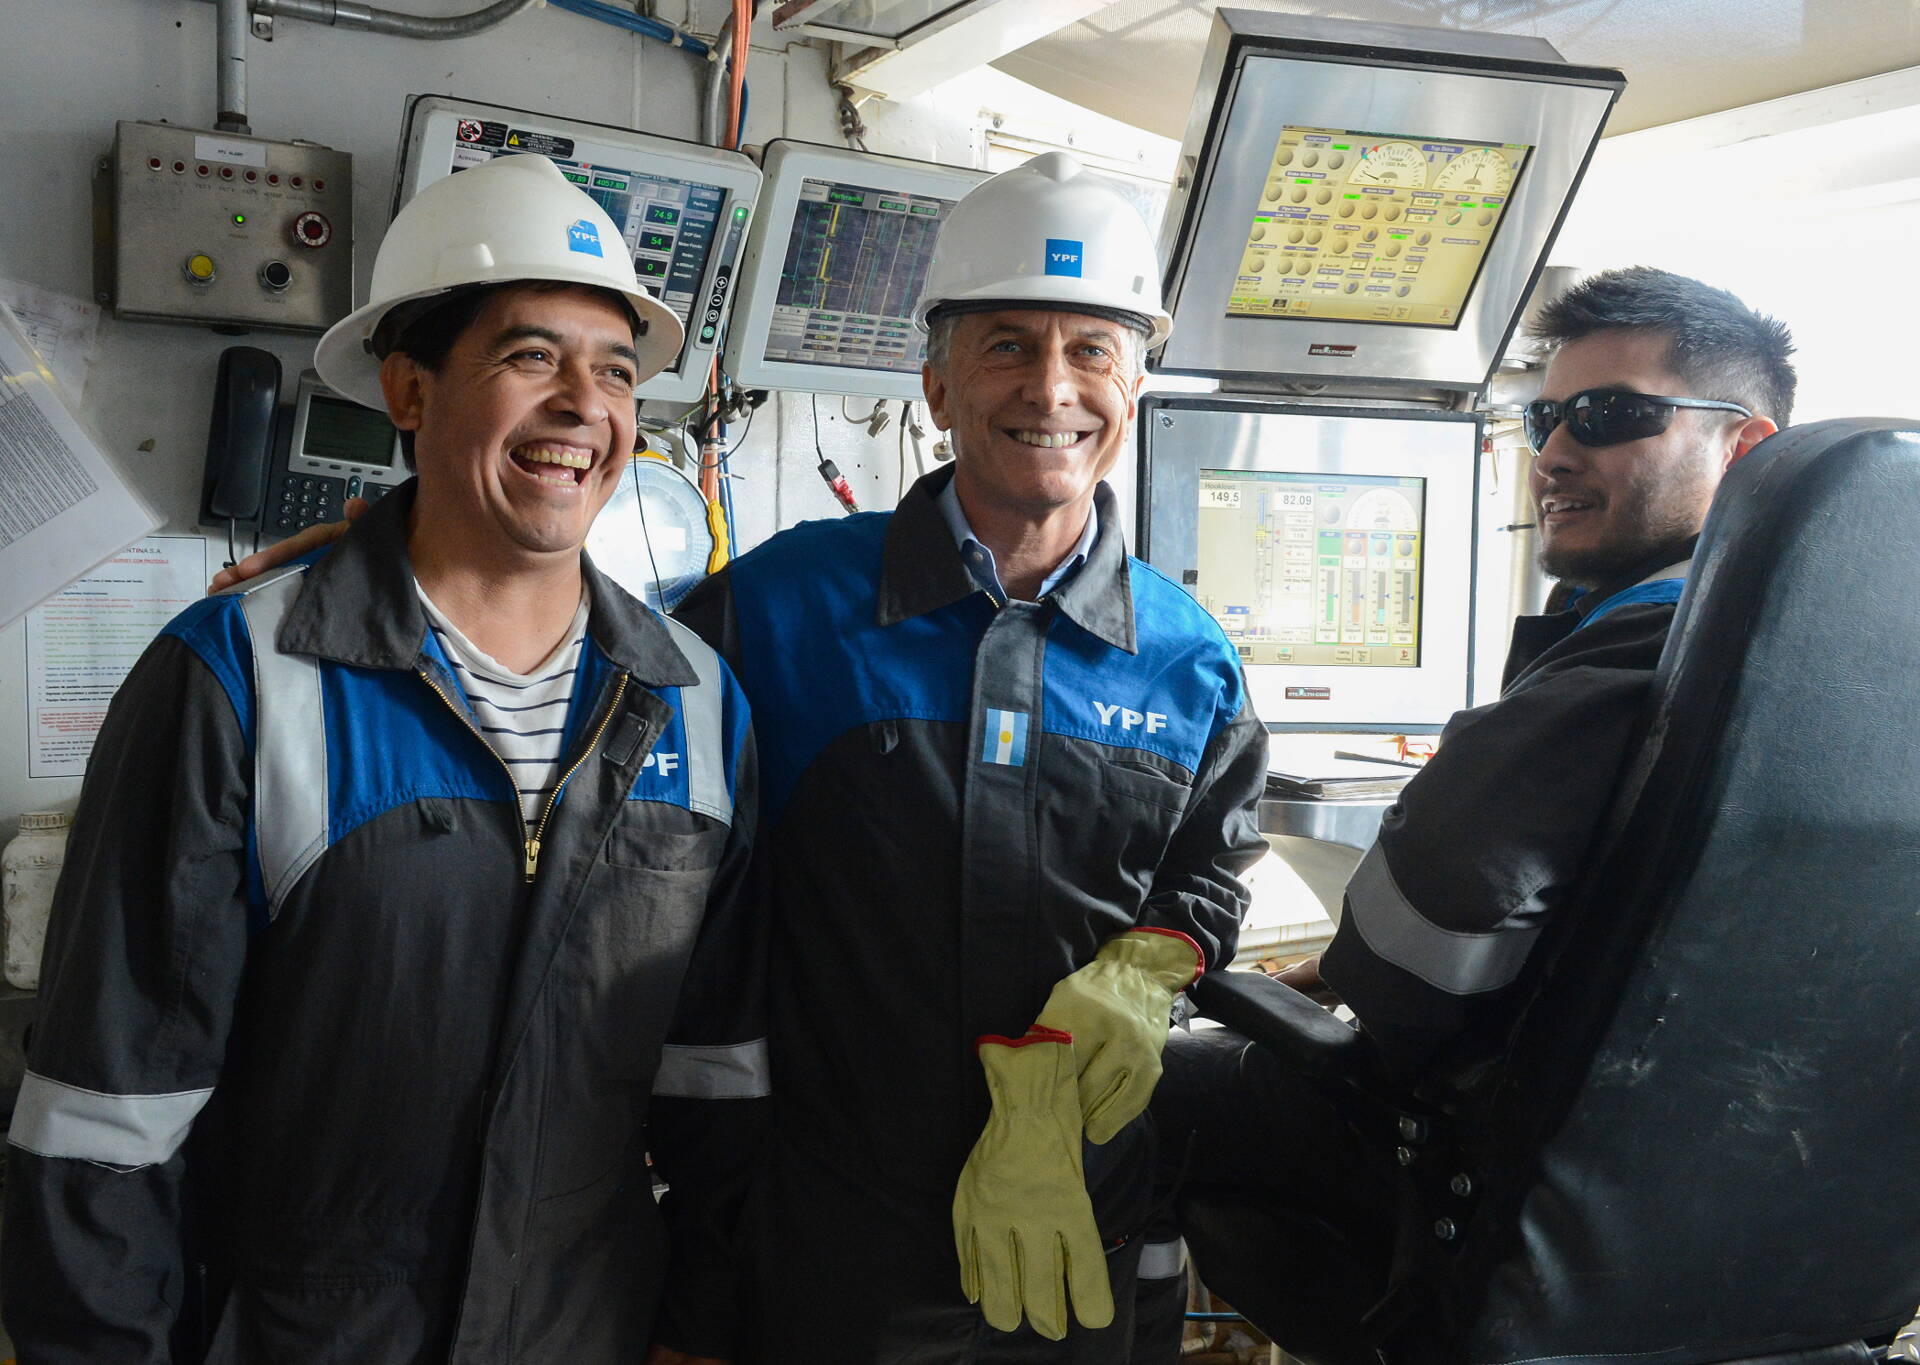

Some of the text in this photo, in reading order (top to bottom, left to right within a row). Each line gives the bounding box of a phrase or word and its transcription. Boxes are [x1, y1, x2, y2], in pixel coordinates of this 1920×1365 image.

[530, 133, 555, 142] WARNING
[527, 142, 555, 152] ATTENTION
[654, 209, 673, 220] 74.9
[570, 230, 599, 243] YPF
[650, 236, 662, 246] 54
[1051, 253, 1079, 263] YPF
[1210, 491, 1240, 502] 149.5
[1283, 494, 1312, 506] 82.09
[1092, 700, 1168, 734] YPF
